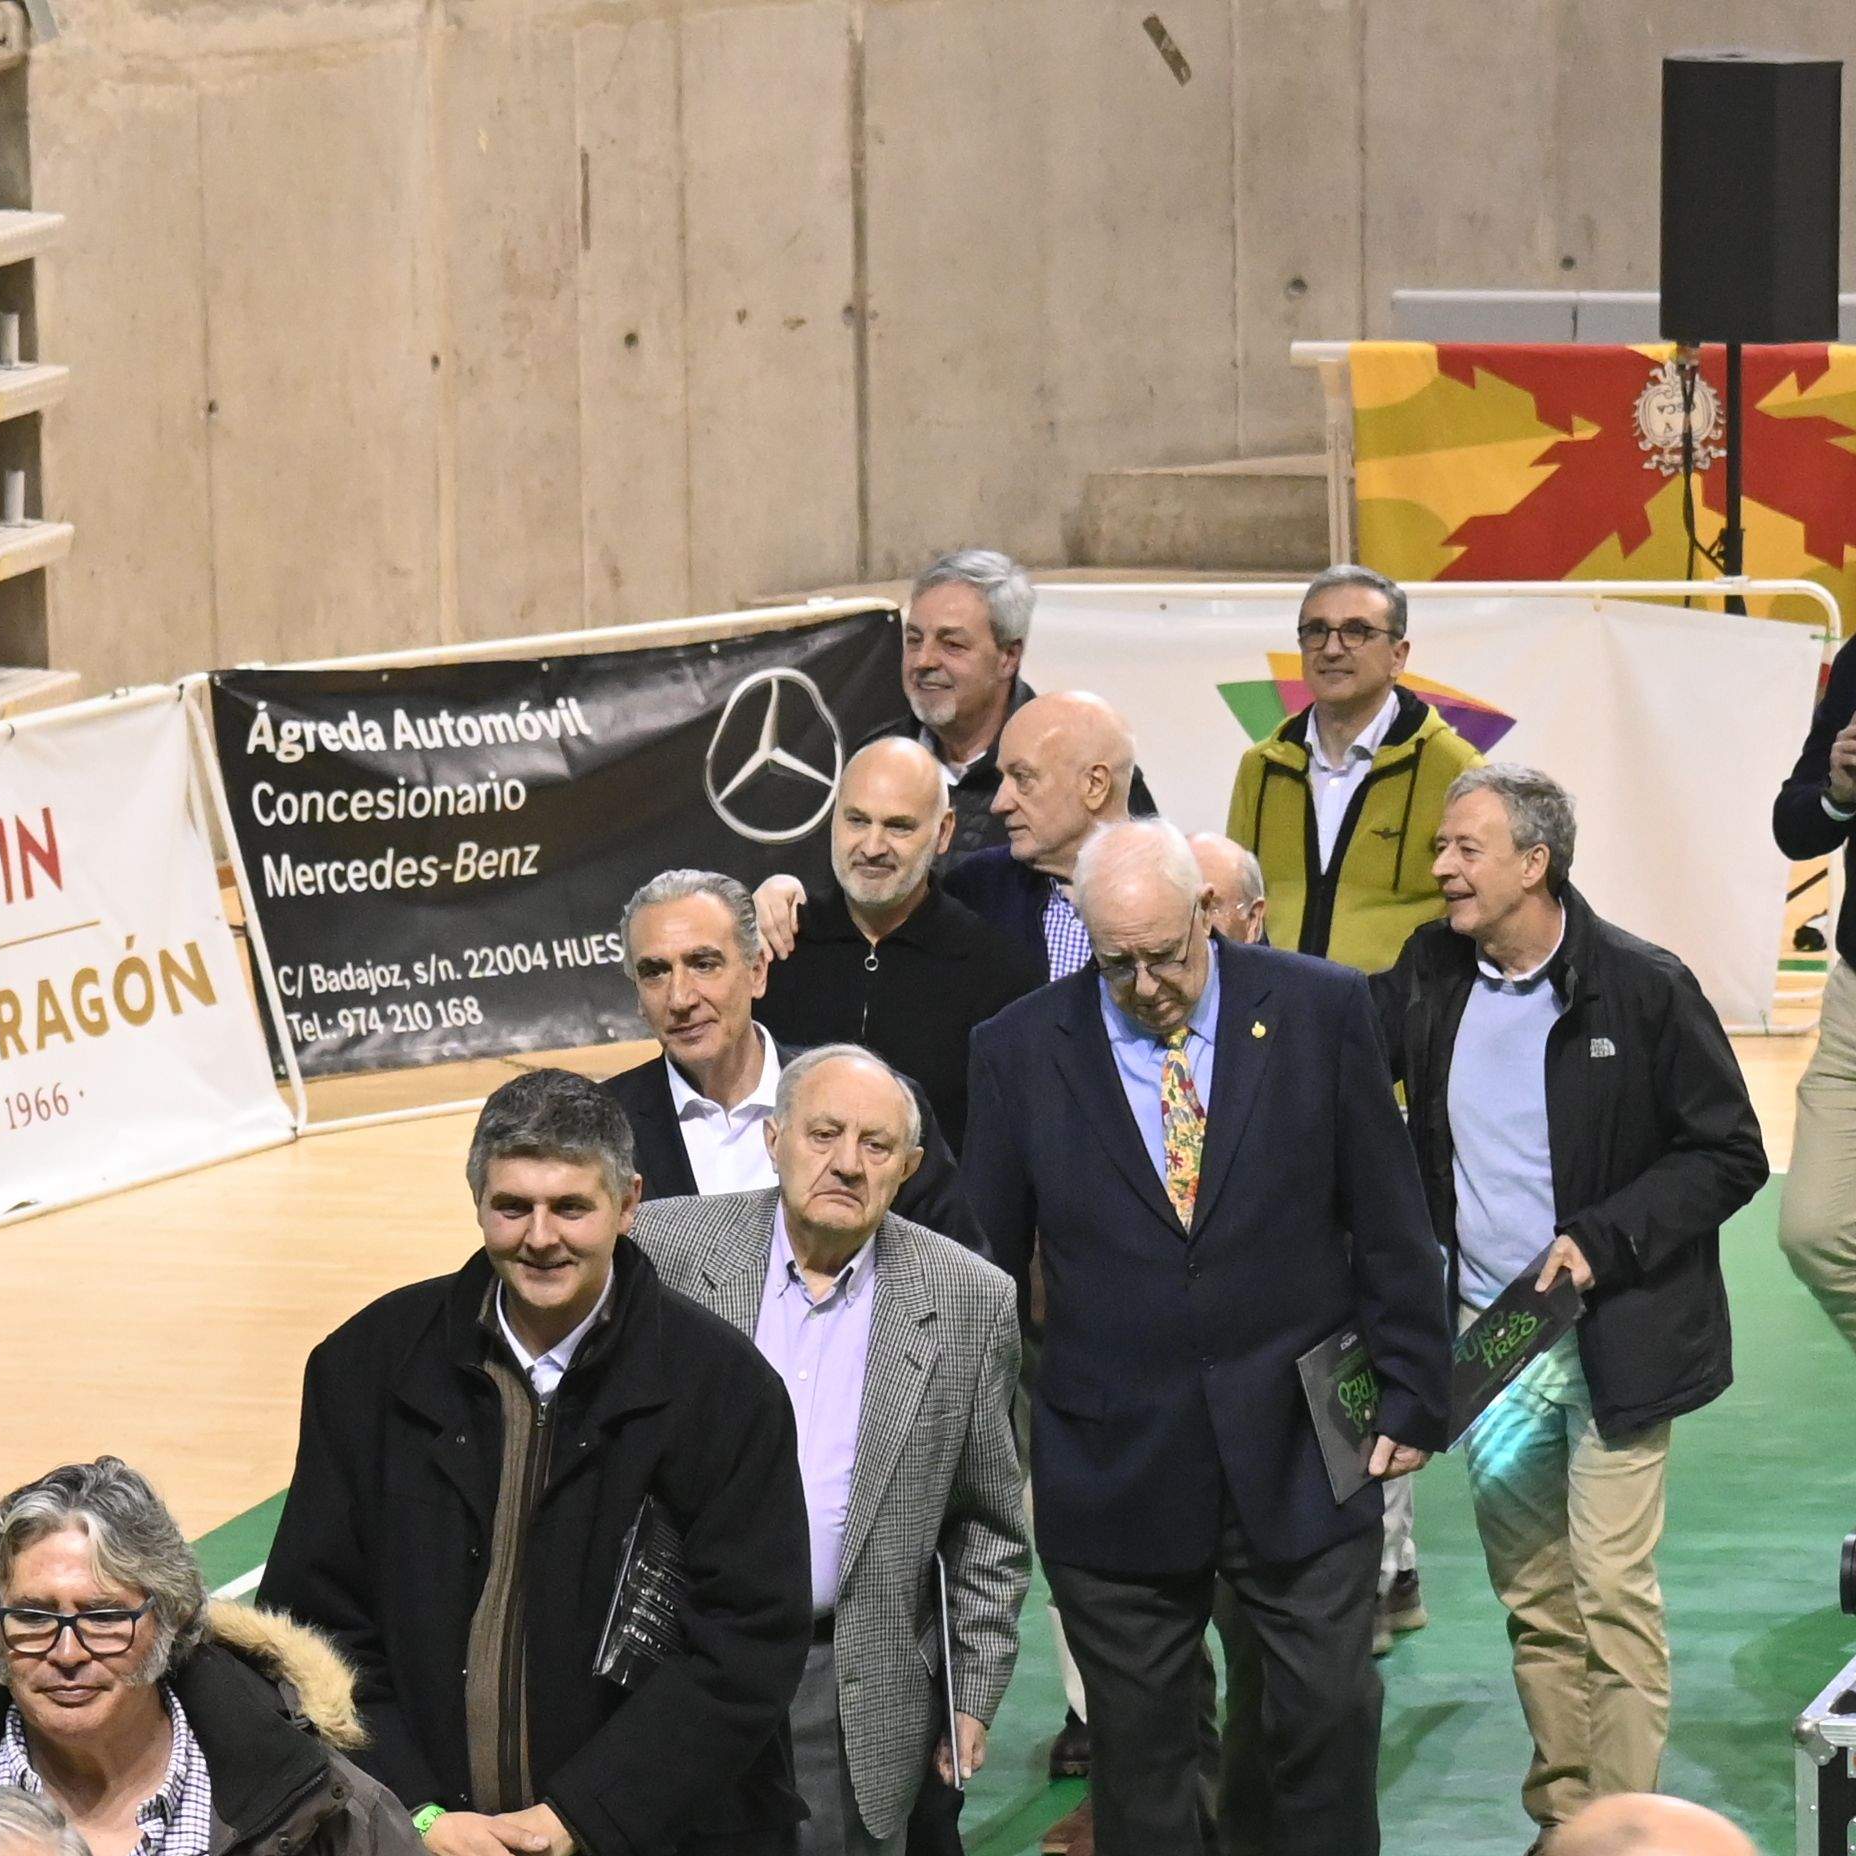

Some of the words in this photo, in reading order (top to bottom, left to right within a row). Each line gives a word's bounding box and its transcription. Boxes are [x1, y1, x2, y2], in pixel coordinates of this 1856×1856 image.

[246, 701, 386, 764] Ágreda
[393, 696, 592, 752] Automóvil
[251, 770, 526, 827] Concesionario
[262, 841, 539, 898] Mercedes-Benz
[278, 965, 304, 999] C/
[309, 959, 411, 996] Badajoz,
[413, 953, 463, 987] s/n.
[463, 941, 550, 979] 22004
[337, 1005, 384, 1038] 974
[387, 1001, 433, 1034] 210
[436, 995, 484, 1029] 168
[4, 1081, 71, 1137] 1966
